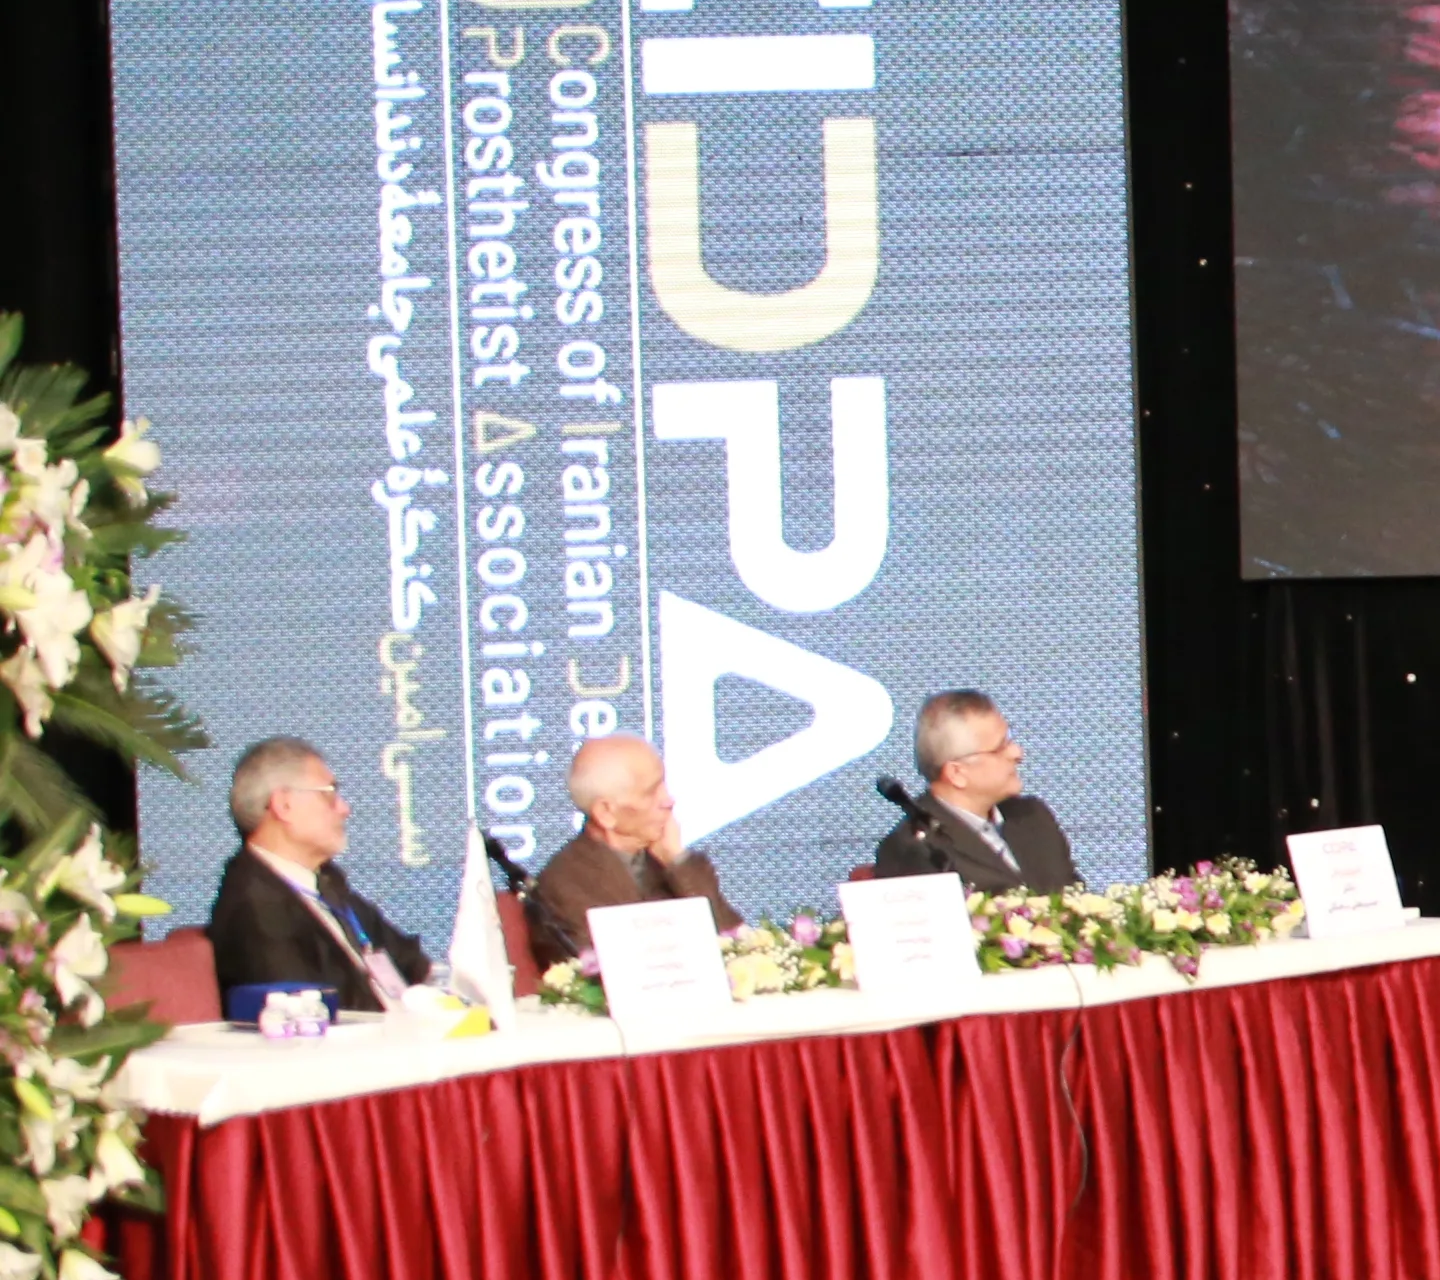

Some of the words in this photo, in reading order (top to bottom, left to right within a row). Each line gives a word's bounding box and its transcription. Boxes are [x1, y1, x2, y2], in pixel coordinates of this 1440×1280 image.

[462, 25, 535, 386] Prosthetist
[539, 25, 612, 325] Congress
[559, 341, 621, 403] of
[474, 410, 544, 860] Association
[561, 422, 626, 636] Iranian
